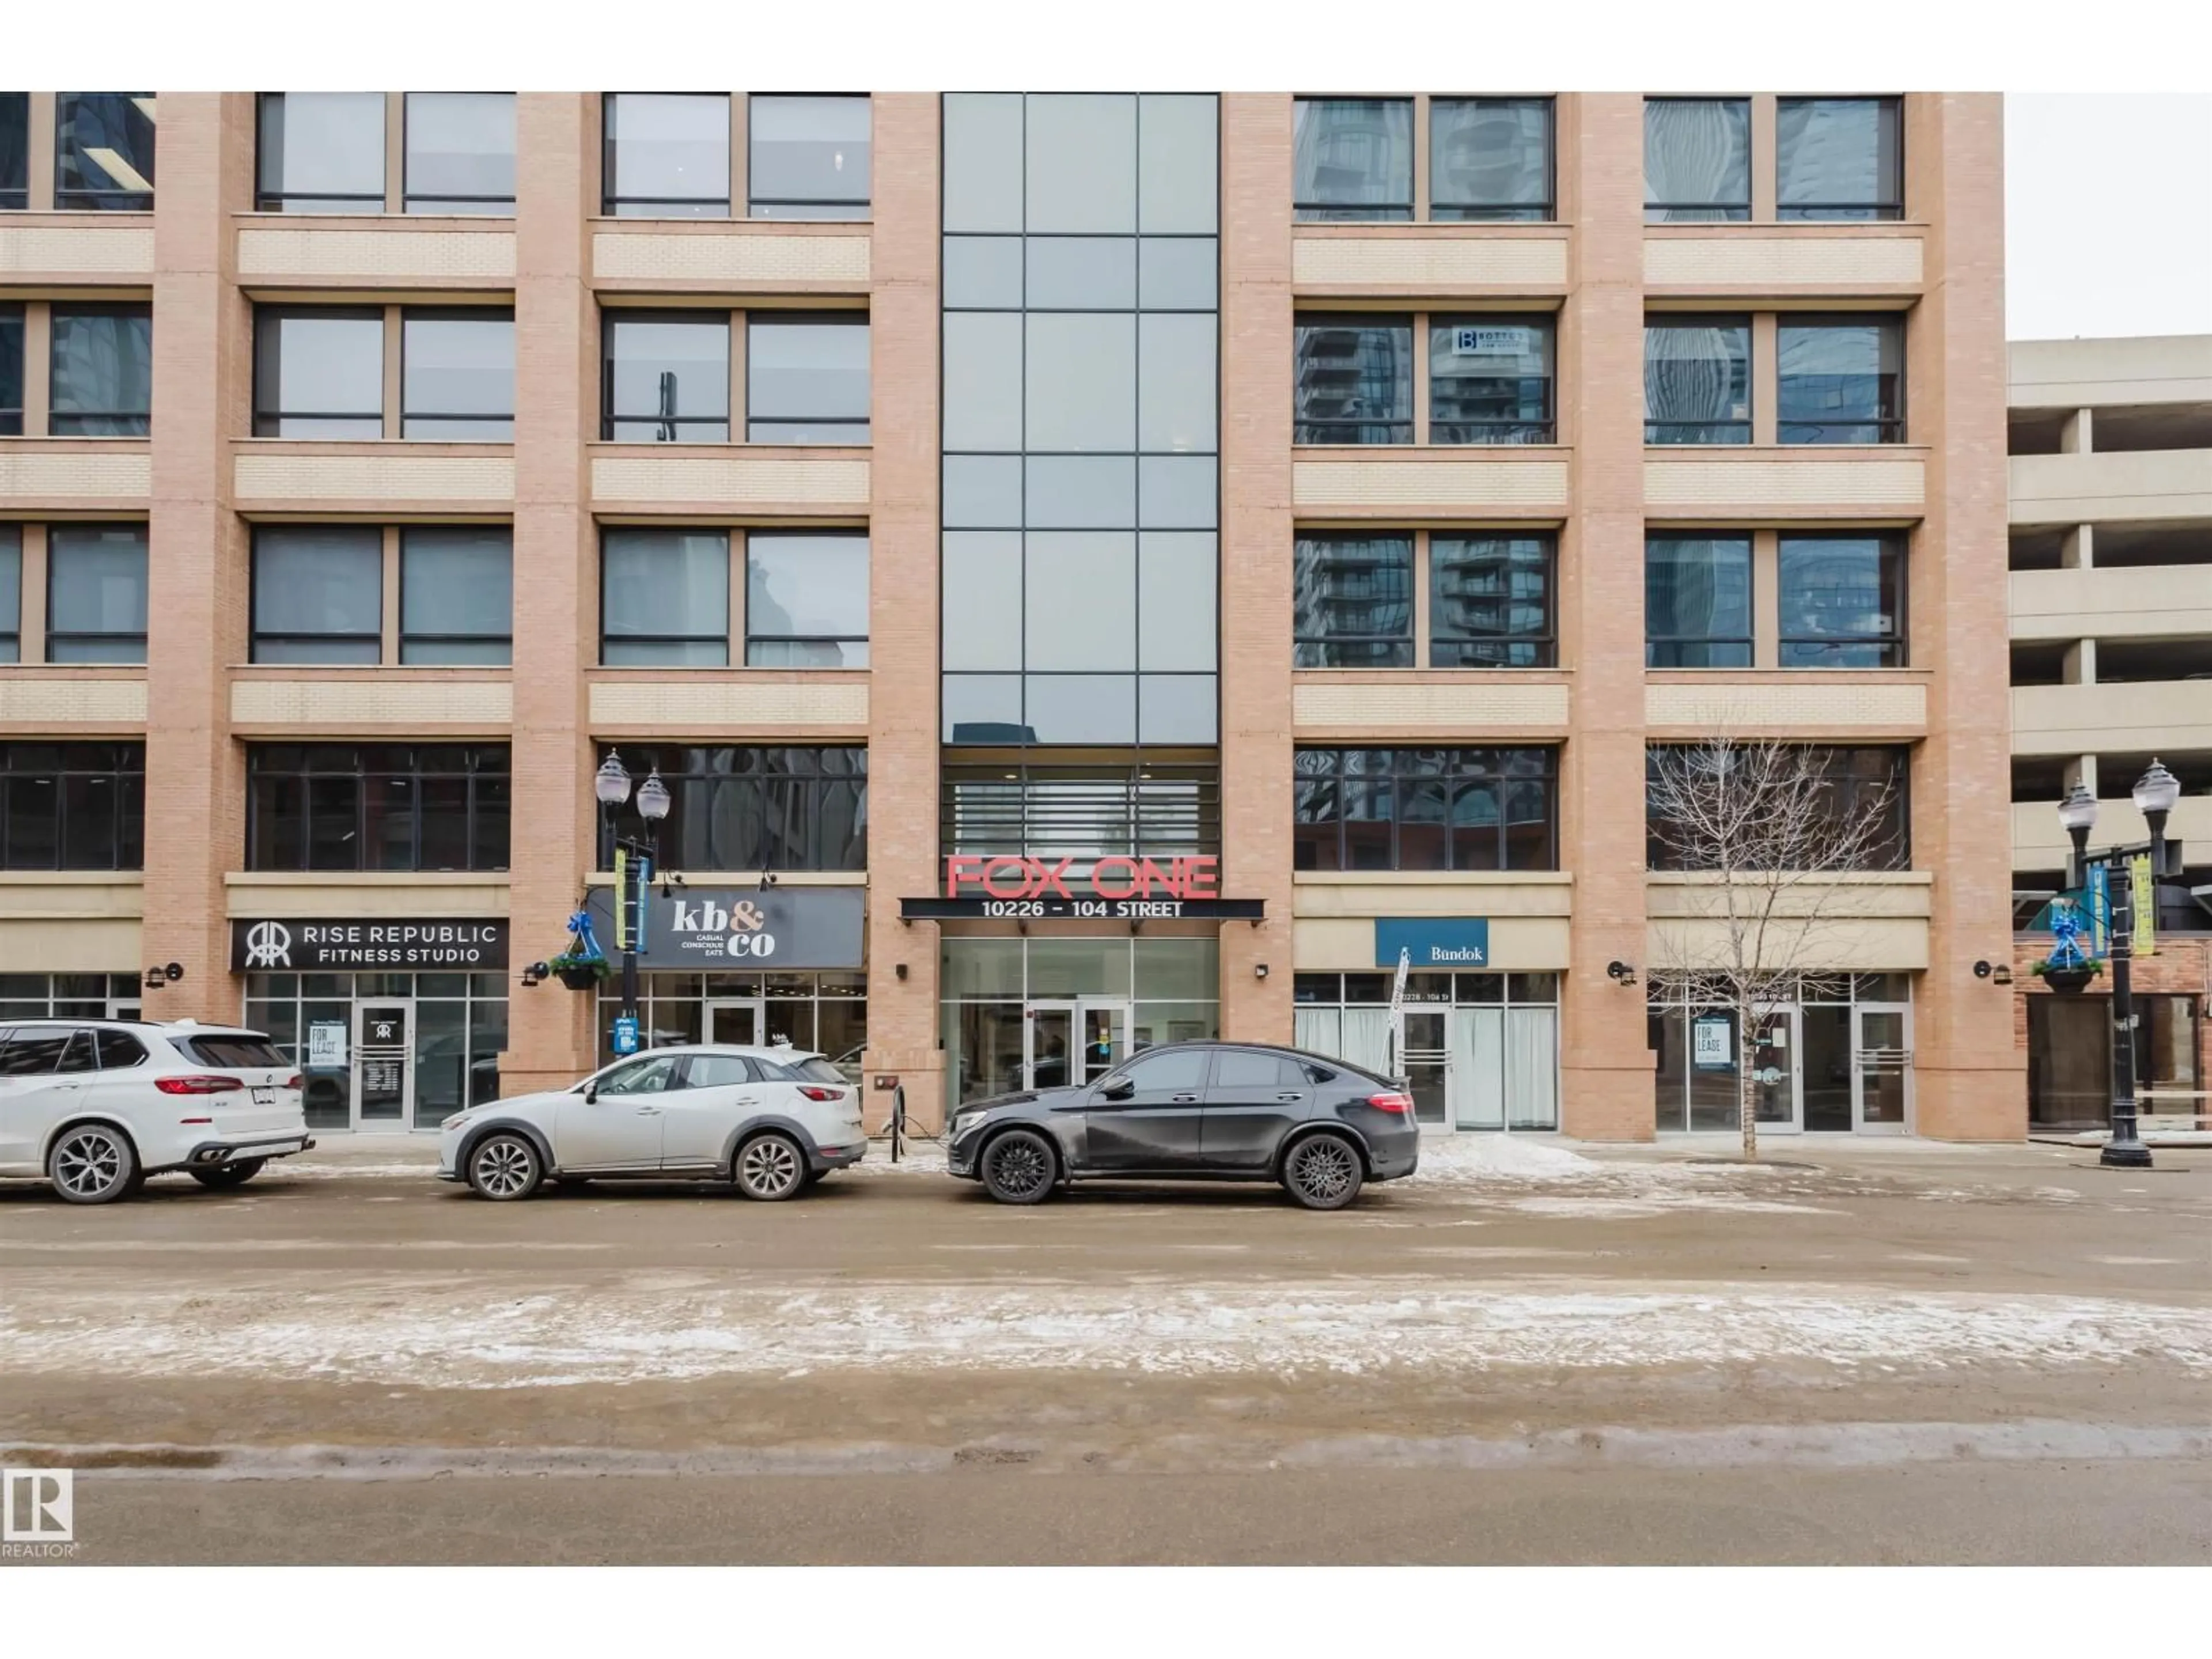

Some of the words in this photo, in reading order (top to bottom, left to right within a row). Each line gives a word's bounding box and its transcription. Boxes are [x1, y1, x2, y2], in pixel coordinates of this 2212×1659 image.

[948, 857, 1073, 899] FOX
[1092, 857, 1217, 899] ONE
[982, 902, 1044, 916] 10226
[1073, 902, 1108, 916] 104
[1117, 902, 1183, 917] STREET
[304, 926, 361, 942] RISE
[370, 926, 497, 942] REPUBLIC
[728, 934, 775, 957] co
[319, 949, 401, 962] FITNESS
[407, 949, 480, 962] STUDIO
[312, 1028, 327, 1040] FOR
[1698, 1026, 1713, 1037] FOR
[312, 1041, 336, 1054] LEASE
[1698, 1040, 1721, 1052] LEASE
